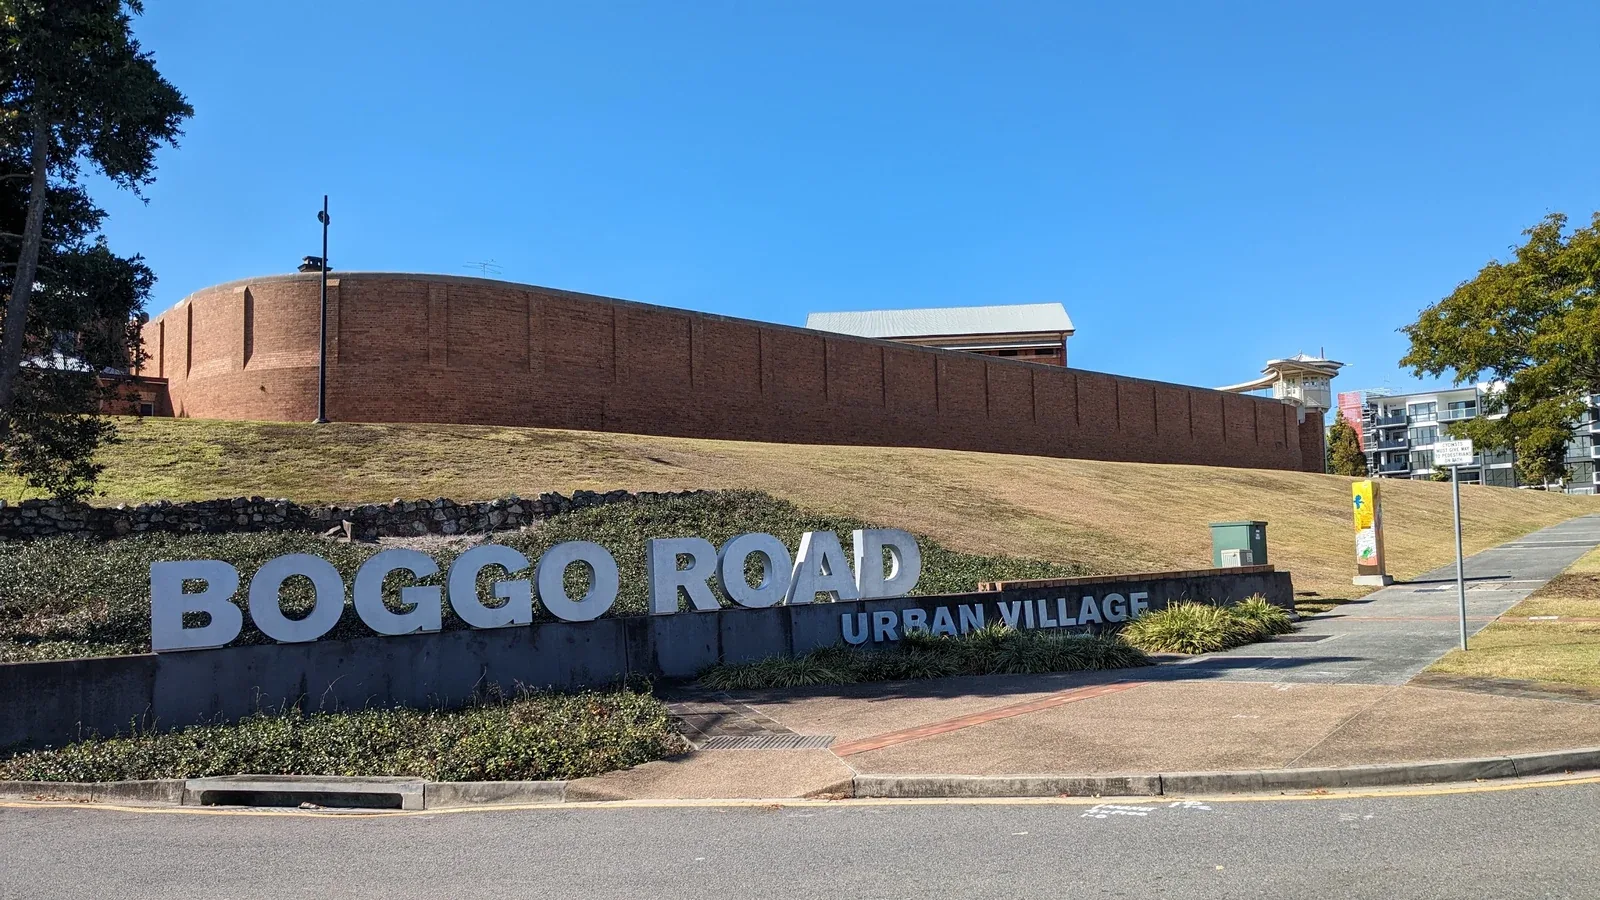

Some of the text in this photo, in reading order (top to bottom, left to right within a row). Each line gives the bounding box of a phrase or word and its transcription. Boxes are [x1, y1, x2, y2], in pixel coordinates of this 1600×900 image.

[150, 528, 922, 651] BOGGO ROAD
[841, 591, 1149, 645] URBAN VILLAGE
